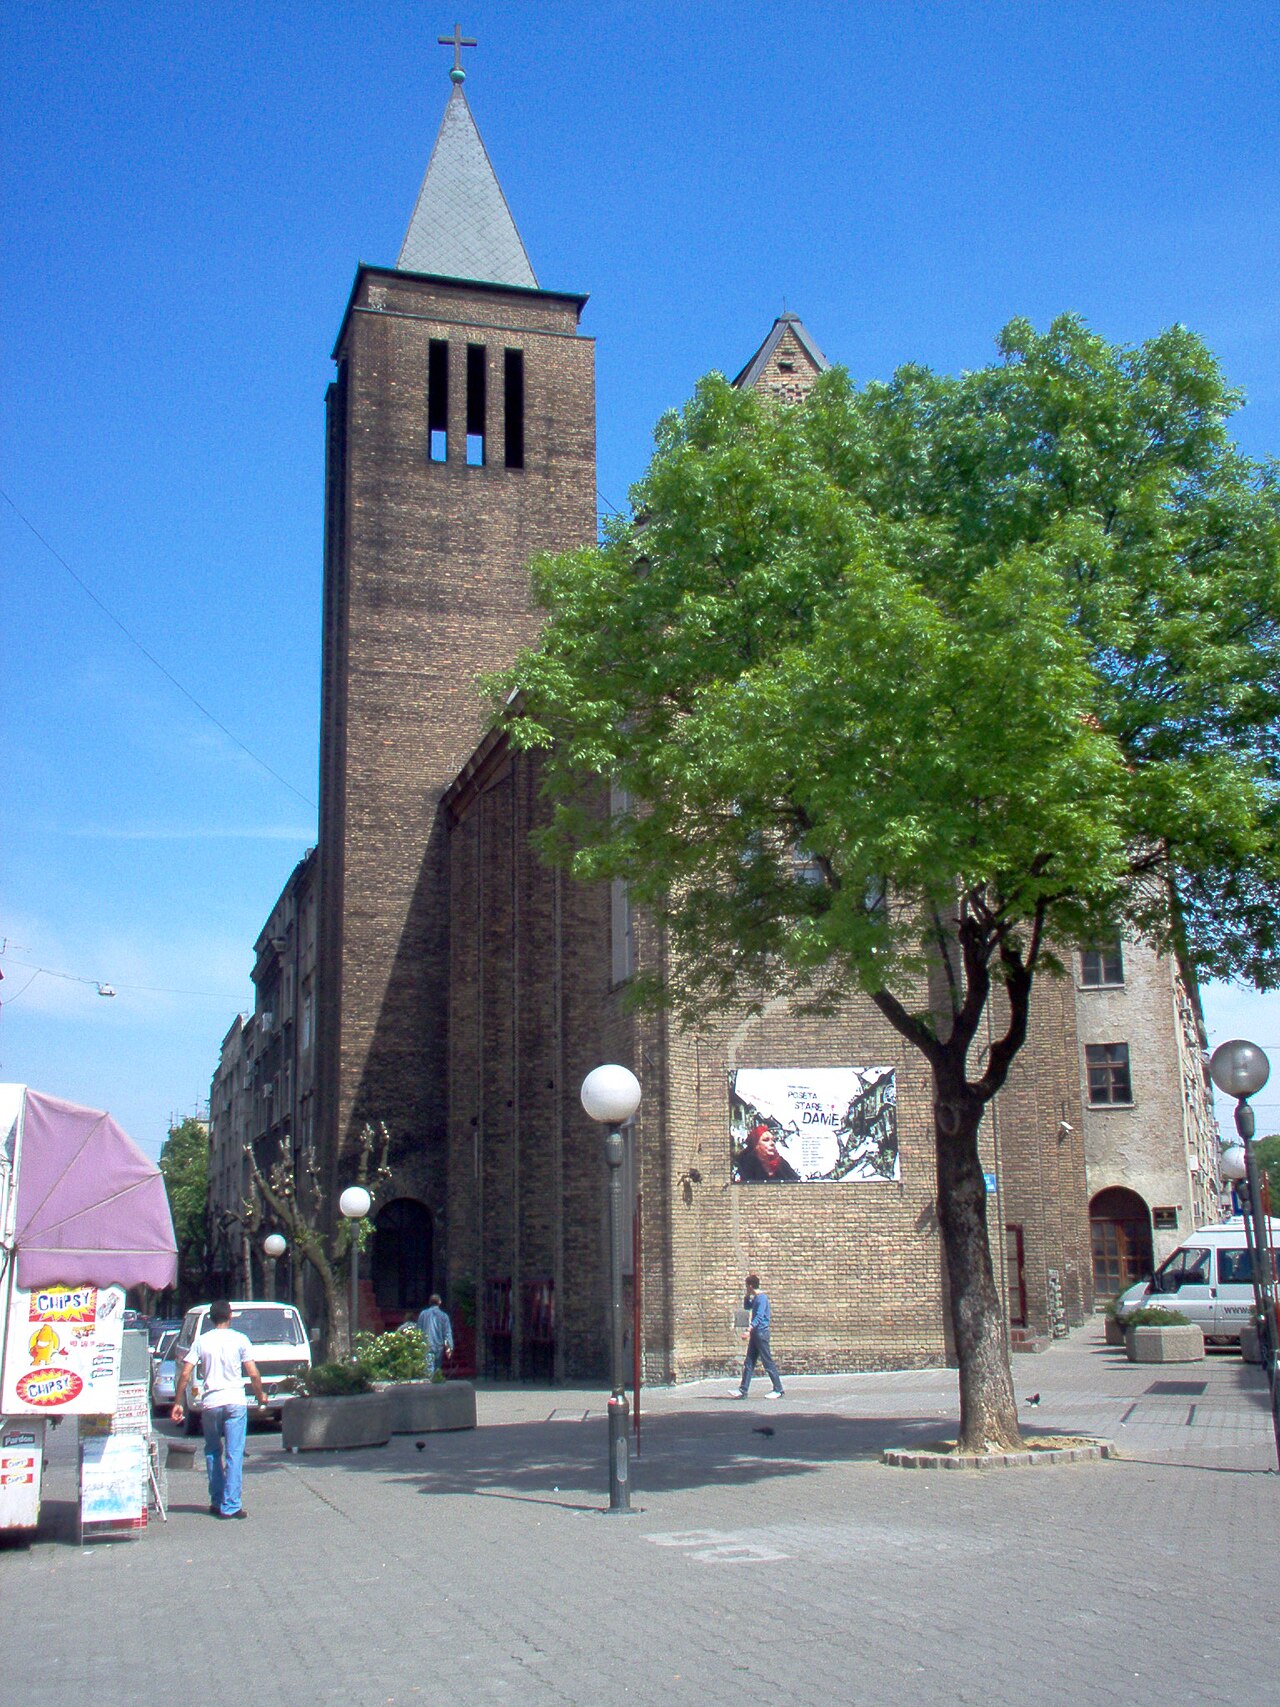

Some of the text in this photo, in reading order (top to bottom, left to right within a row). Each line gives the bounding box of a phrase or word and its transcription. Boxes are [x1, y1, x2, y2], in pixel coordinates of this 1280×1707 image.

[794, 1101, 824, 1112] STARE
[802, 1112, 840, 1126] DAME
[37, 1292, 90, 1311] CHIPSY
[28, 1377, 69, 1398] CHIPSY
